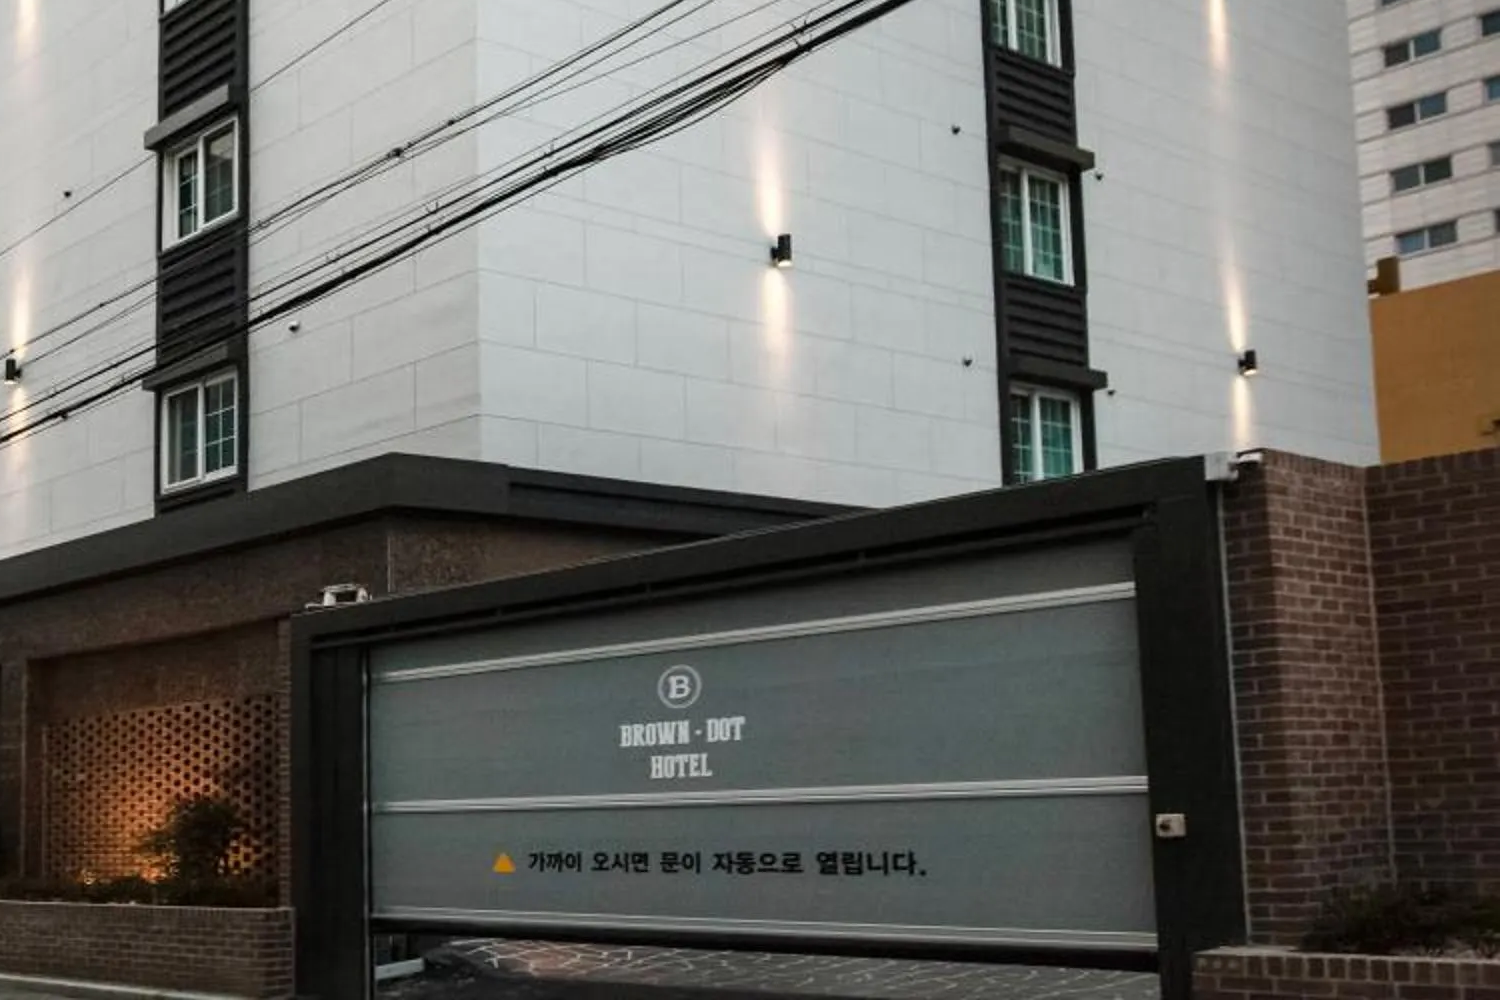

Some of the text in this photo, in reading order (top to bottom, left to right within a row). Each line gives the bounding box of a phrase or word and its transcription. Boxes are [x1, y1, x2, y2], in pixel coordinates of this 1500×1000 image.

[619, 720, 690, 747] BROWN
[706, 716, 746, 742] DOT
[650, 753, 713, 779] HOTEL
[528, 850, 927, 876] 가까이 오시면 문이 자동으로 열립니다.
